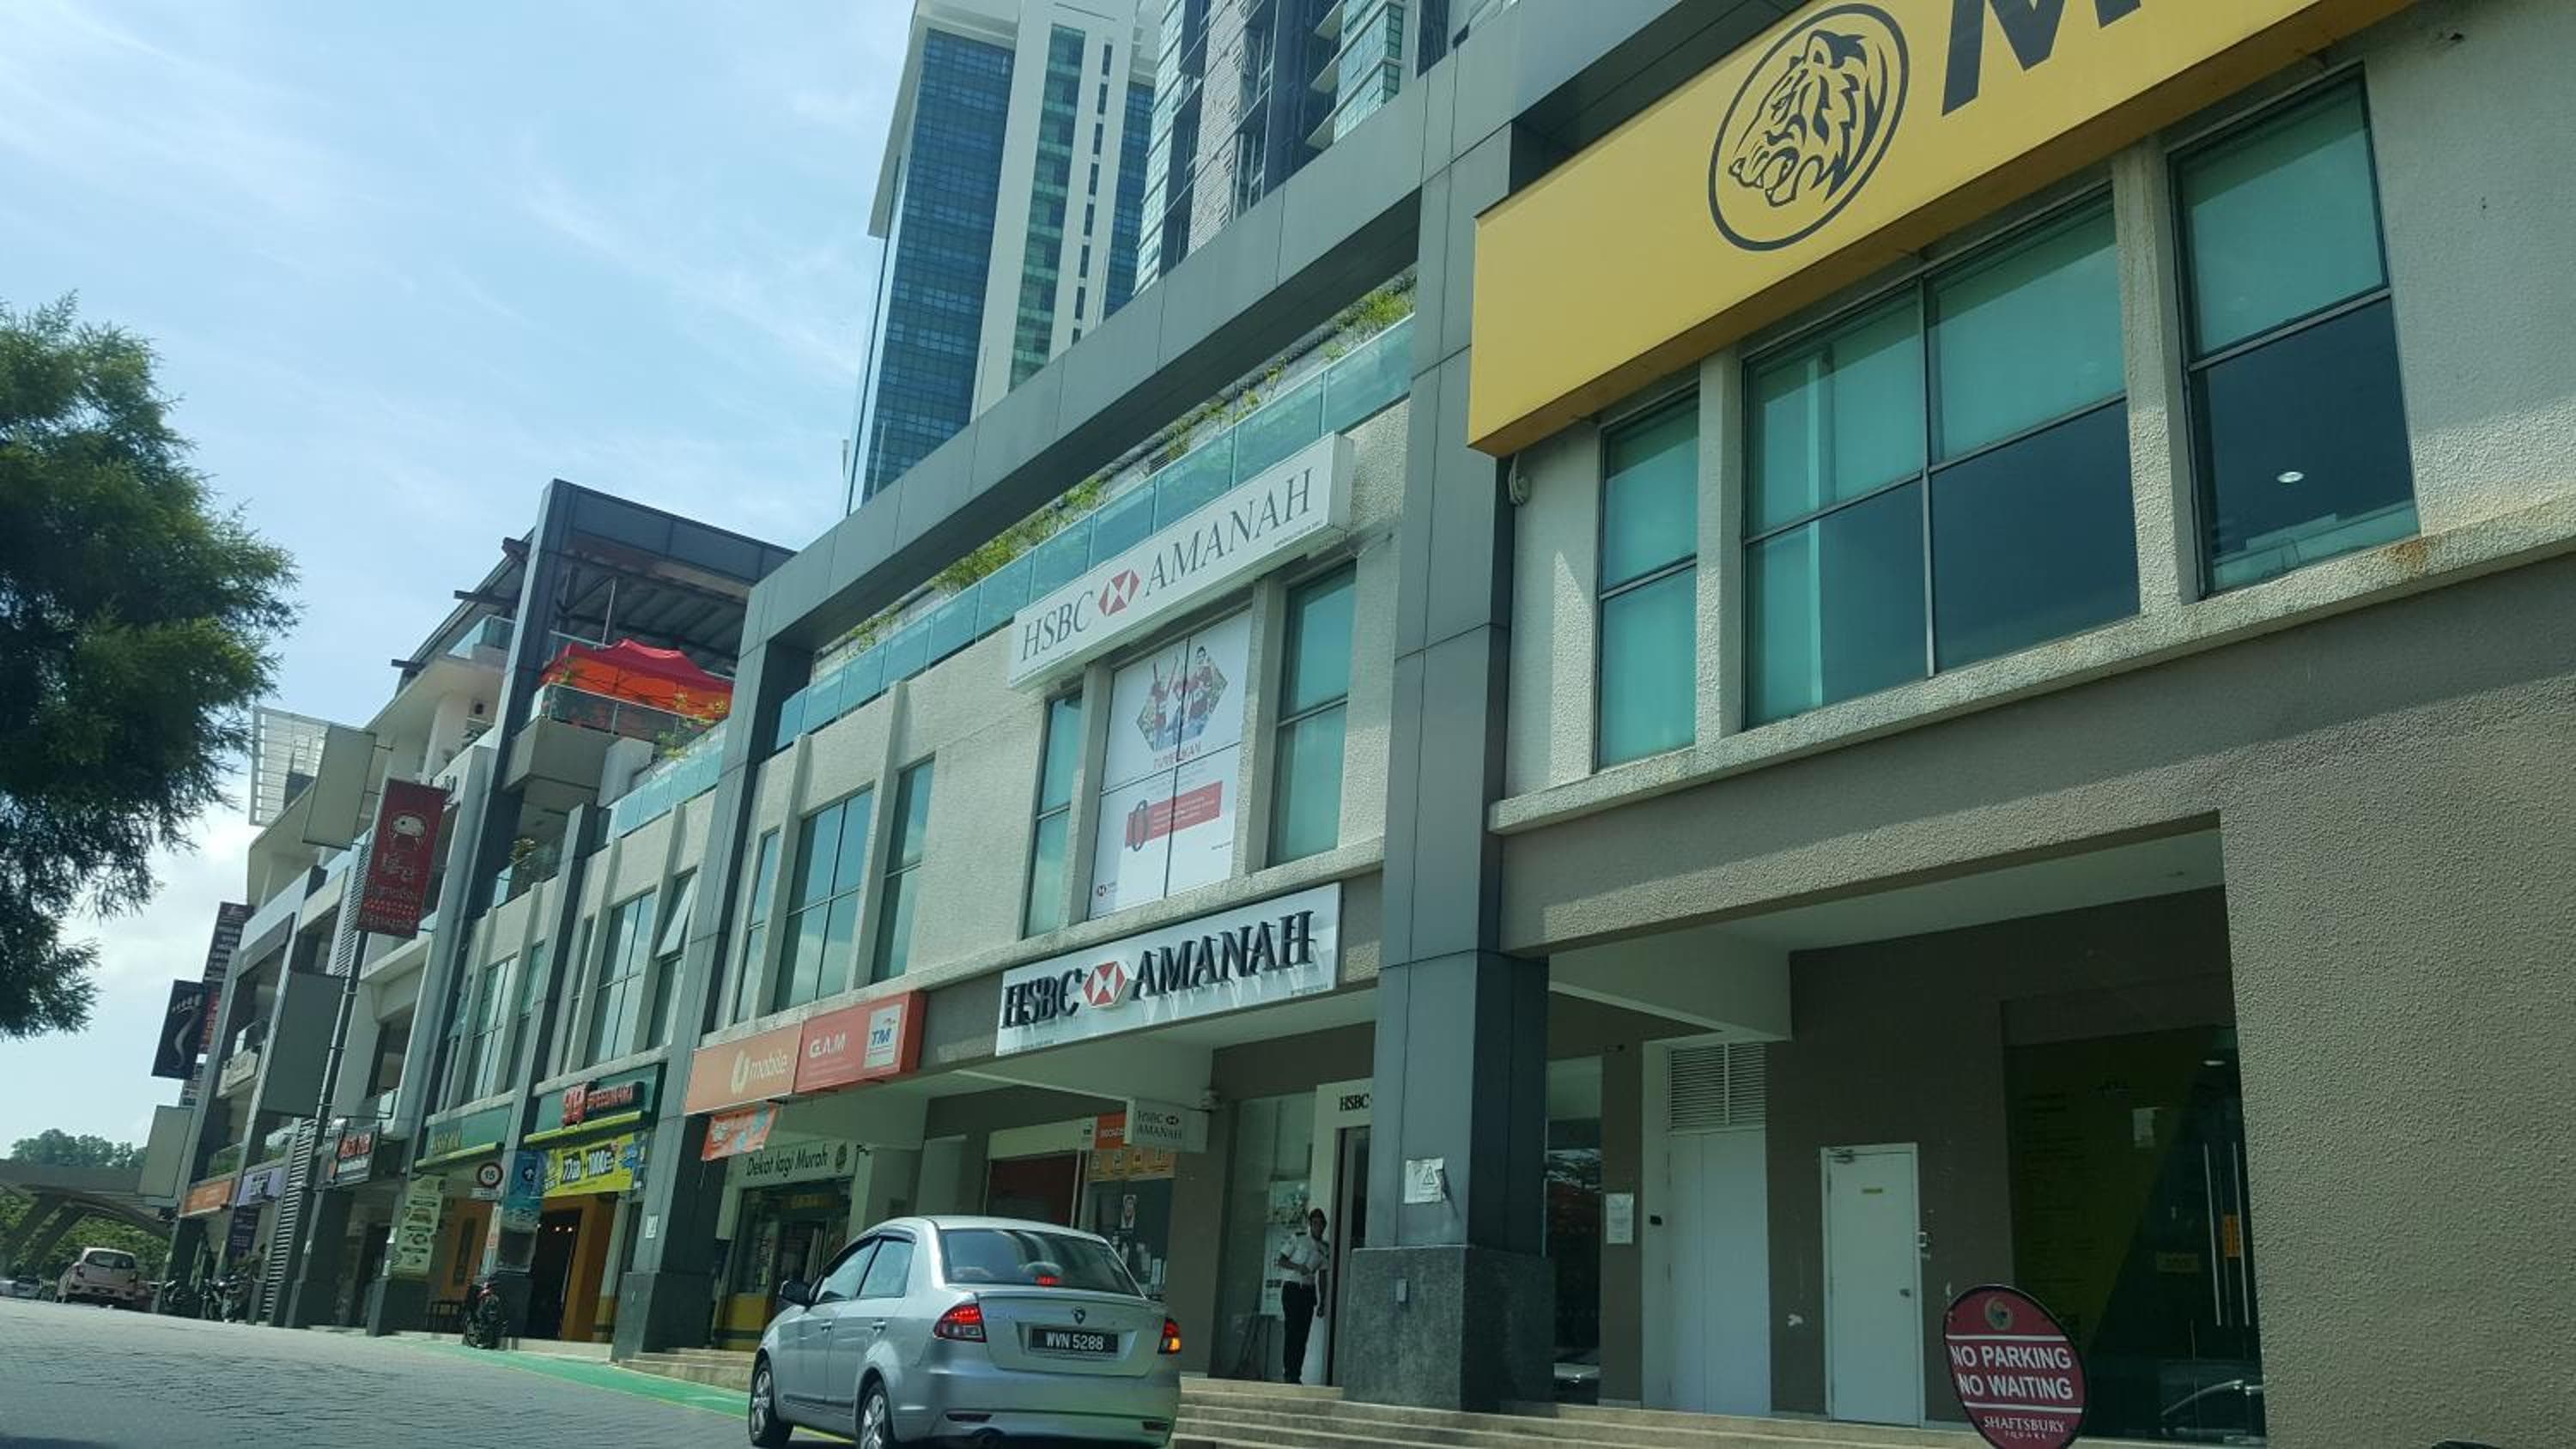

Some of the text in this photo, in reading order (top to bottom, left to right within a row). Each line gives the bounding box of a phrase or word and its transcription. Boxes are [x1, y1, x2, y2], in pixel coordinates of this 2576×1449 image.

[1021, 467, 1314, 662] HSBC AMANAH
[1000, 909, 1316, 1029] HSBC AMANAH
[872, 1028, 892, 1046] TM
[1340, 1094, 1370, 1112] HSBC
[1045, 1331, 1104, 1351] WVN 5288
[1949, 1345, 2072, 1369] NO PARKING
[1957, 1373, 2074, 1400] NO WAITING
[1984, 1416, 2065, 1434] SHAFTSBURY
